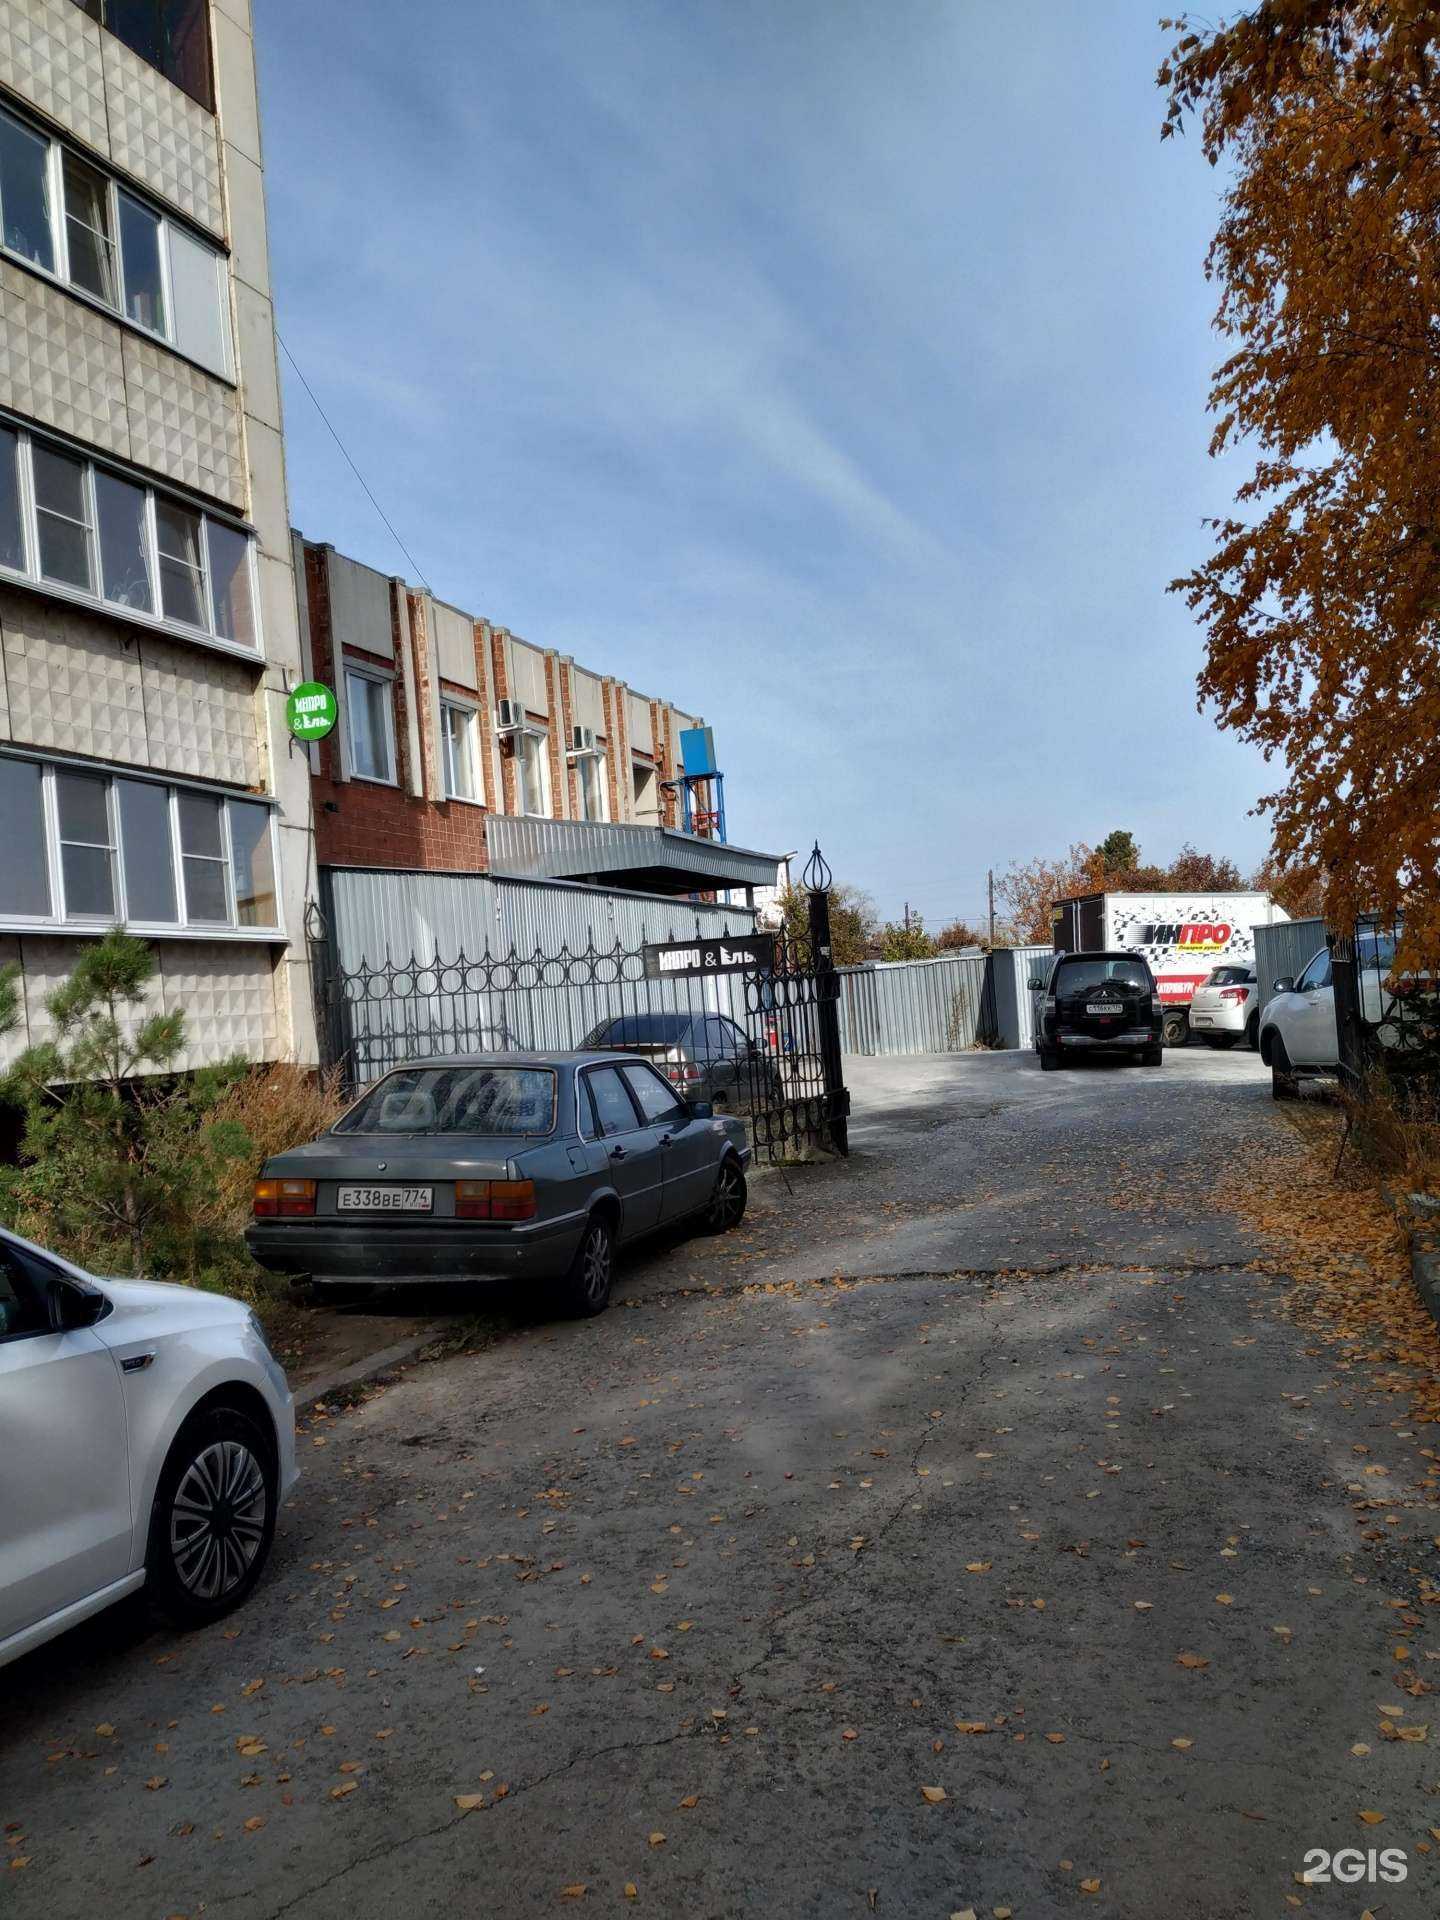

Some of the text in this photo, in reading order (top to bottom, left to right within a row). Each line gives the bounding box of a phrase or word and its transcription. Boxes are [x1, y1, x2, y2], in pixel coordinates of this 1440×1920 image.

[295, 694, 327, 713] ИНПРО
[293, 718, 303, 730] &
[1142, 923, 1232, 945] ИНПРО
[658, 949, 701, 971] ИНПРО
[704, 951, 717, 967] &
